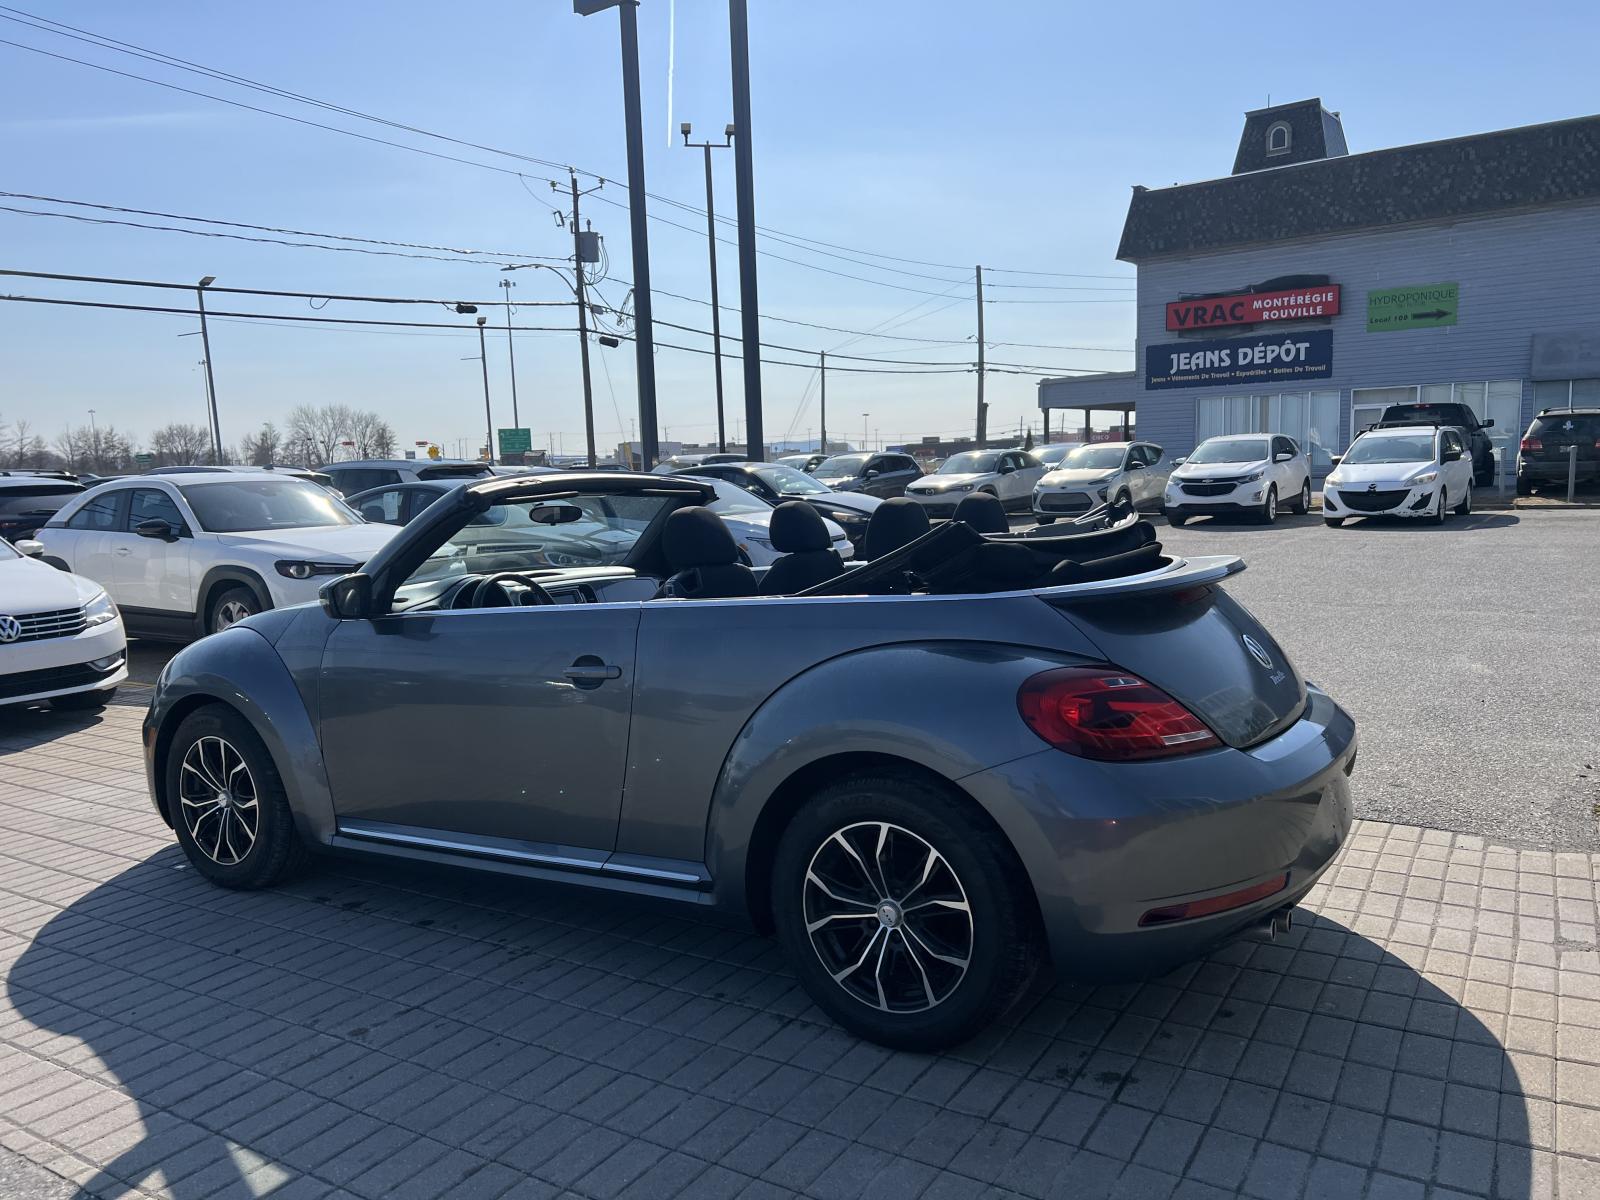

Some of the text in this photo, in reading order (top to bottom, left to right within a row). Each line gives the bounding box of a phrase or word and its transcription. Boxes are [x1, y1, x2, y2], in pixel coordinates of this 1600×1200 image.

[1253, 292, 1333, 309] MONTÉRÉGIE
[1369, 289, 1455, 306] HYDROPONIQUE
[1174, 302, 1244, 326] VRAC
[1263, 306, 1323, 320] ROUVILLE
[1170, 340, 1310, 375] JEANS DÉPÔT
